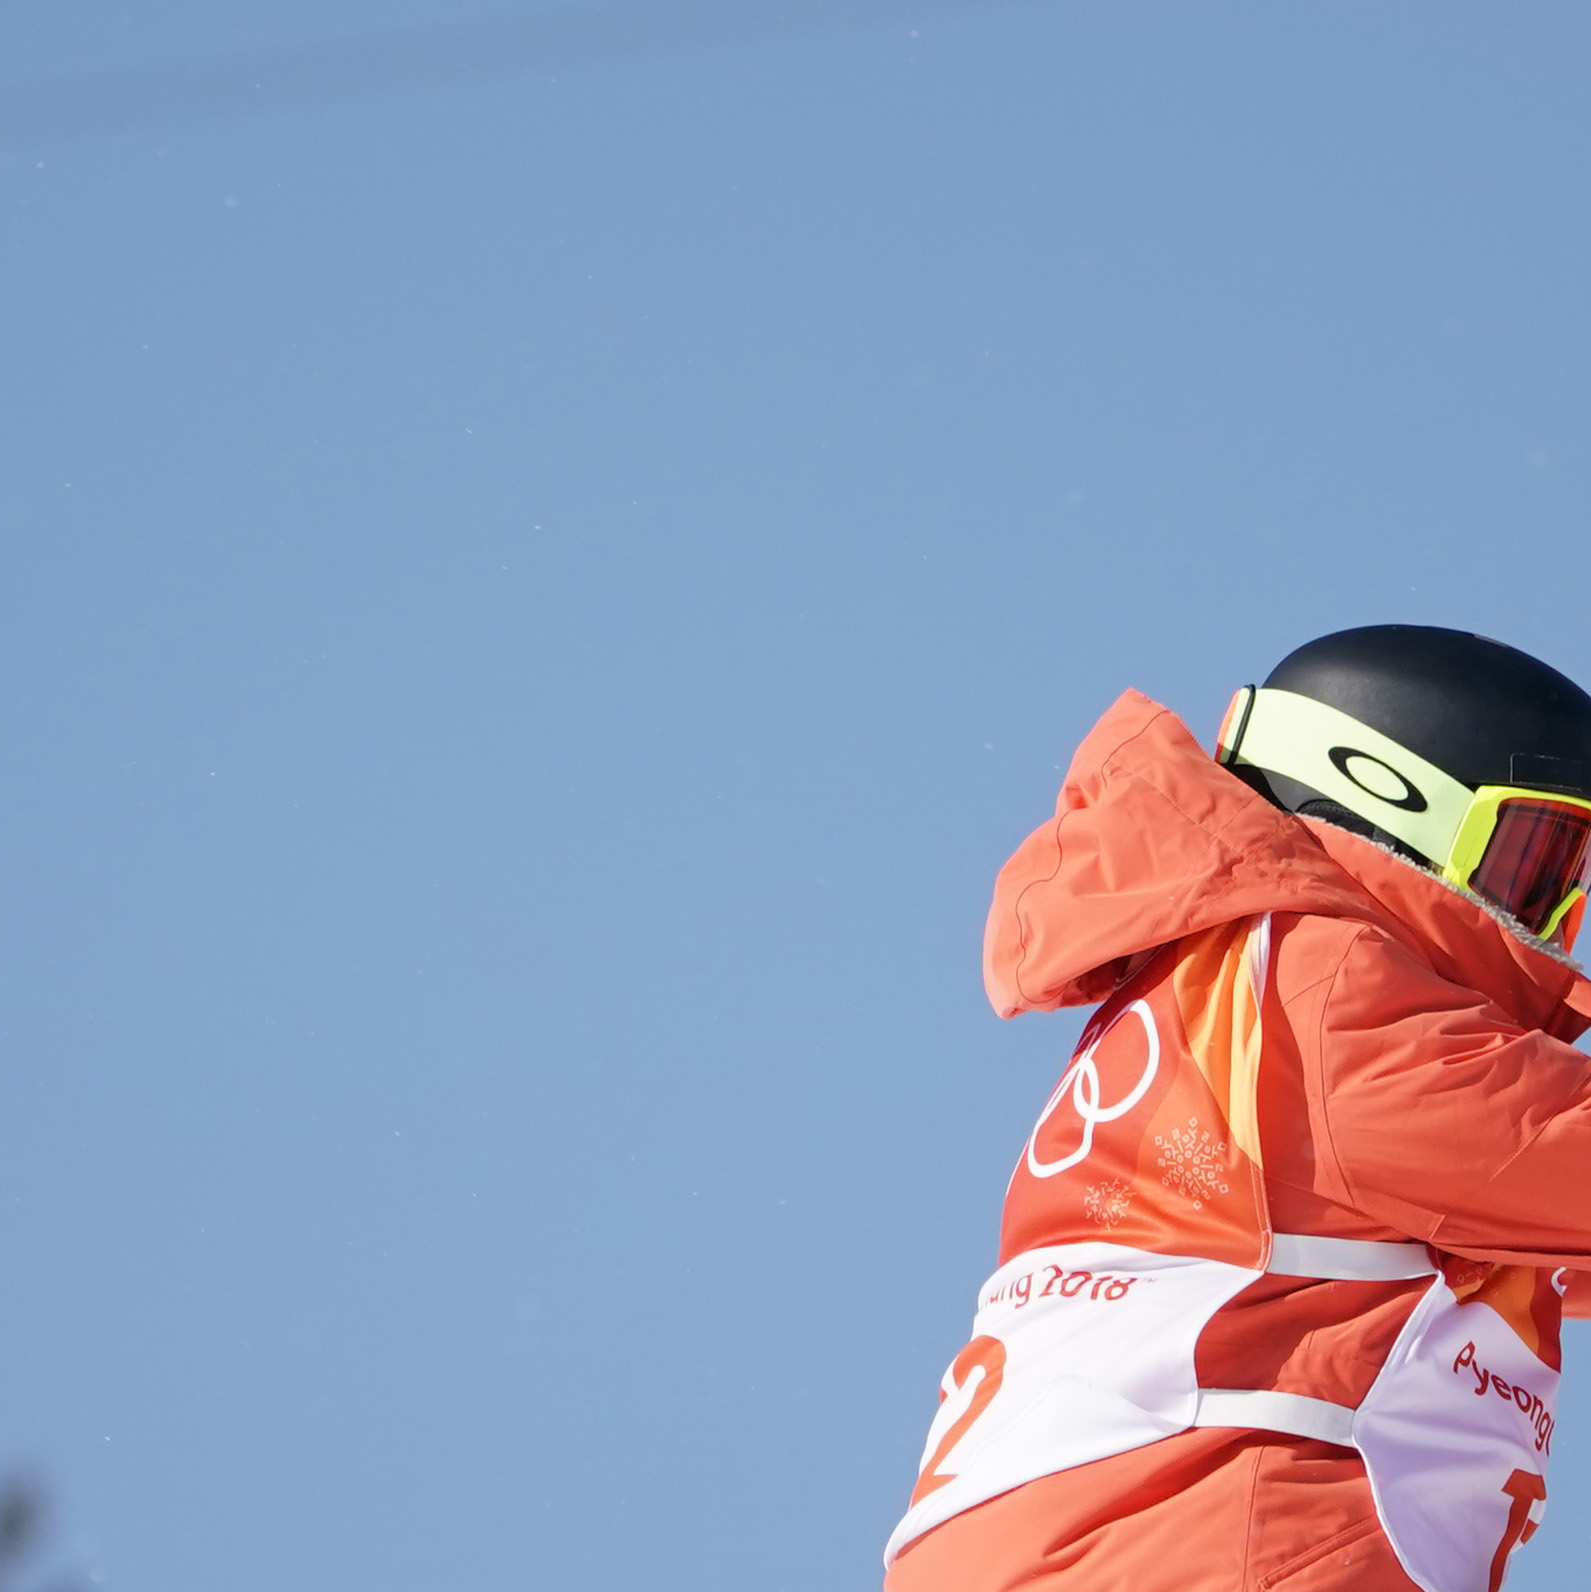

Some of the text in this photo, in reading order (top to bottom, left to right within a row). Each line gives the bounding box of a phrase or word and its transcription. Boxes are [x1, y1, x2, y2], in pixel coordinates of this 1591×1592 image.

[984, 1273, 1034, 1309] ang
[1039, 1264, 1138, 1301] 2018
[1453, 1341, 1555, 1457] Pyeong
